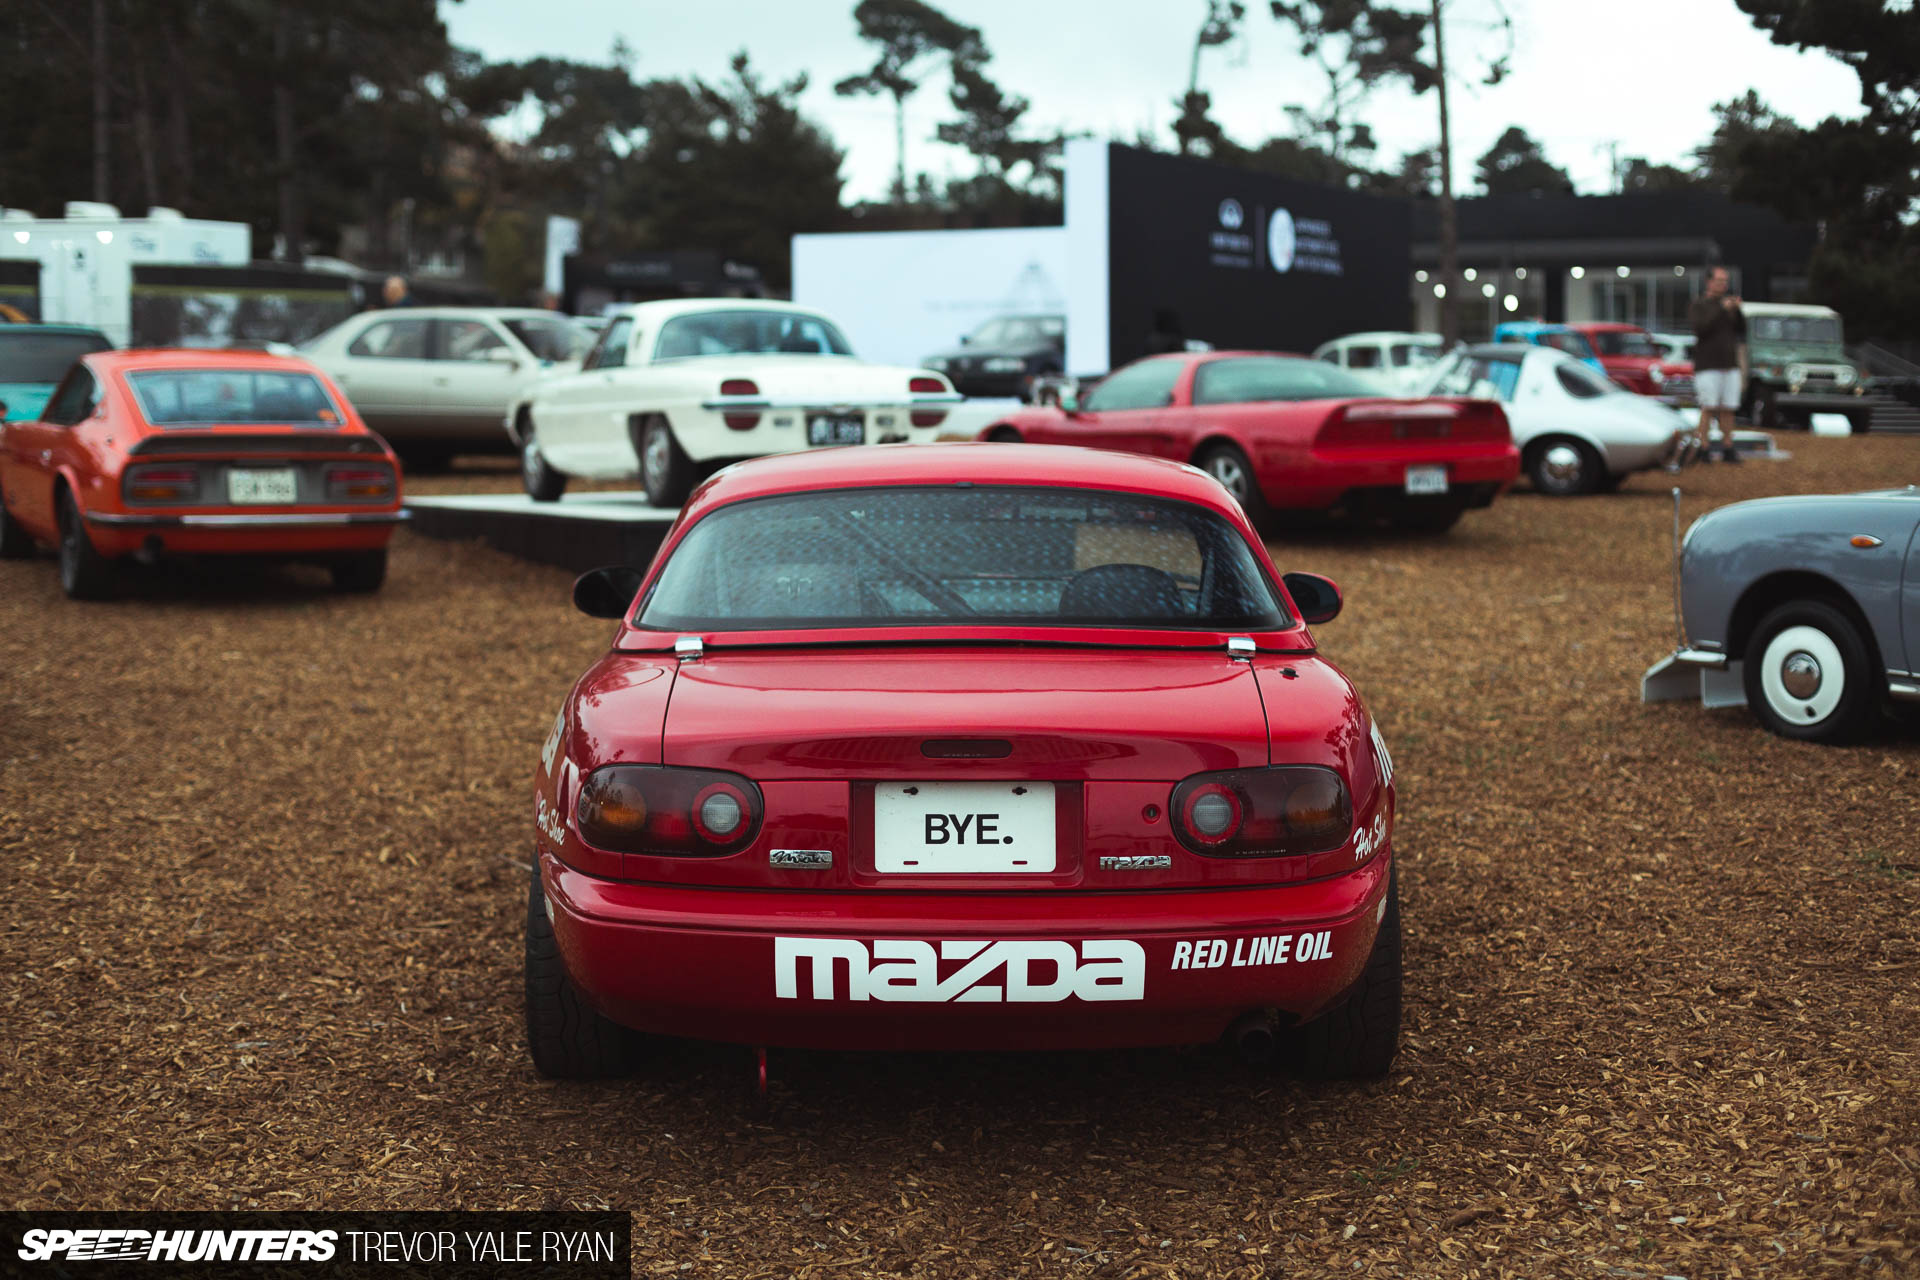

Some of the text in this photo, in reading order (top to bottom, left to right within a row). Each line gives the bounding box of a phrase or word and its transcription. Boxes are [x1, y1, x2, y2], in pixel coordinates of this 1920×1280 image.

[925, 813, 1014, 845] BYE.
[1353, 826, 1373, 862] Hot
[1100, 855, 1172, 870] mazda
[1171, 930, 1334, 970] RED LINE OIL
[775, 937, 1146, 1003] mazda
